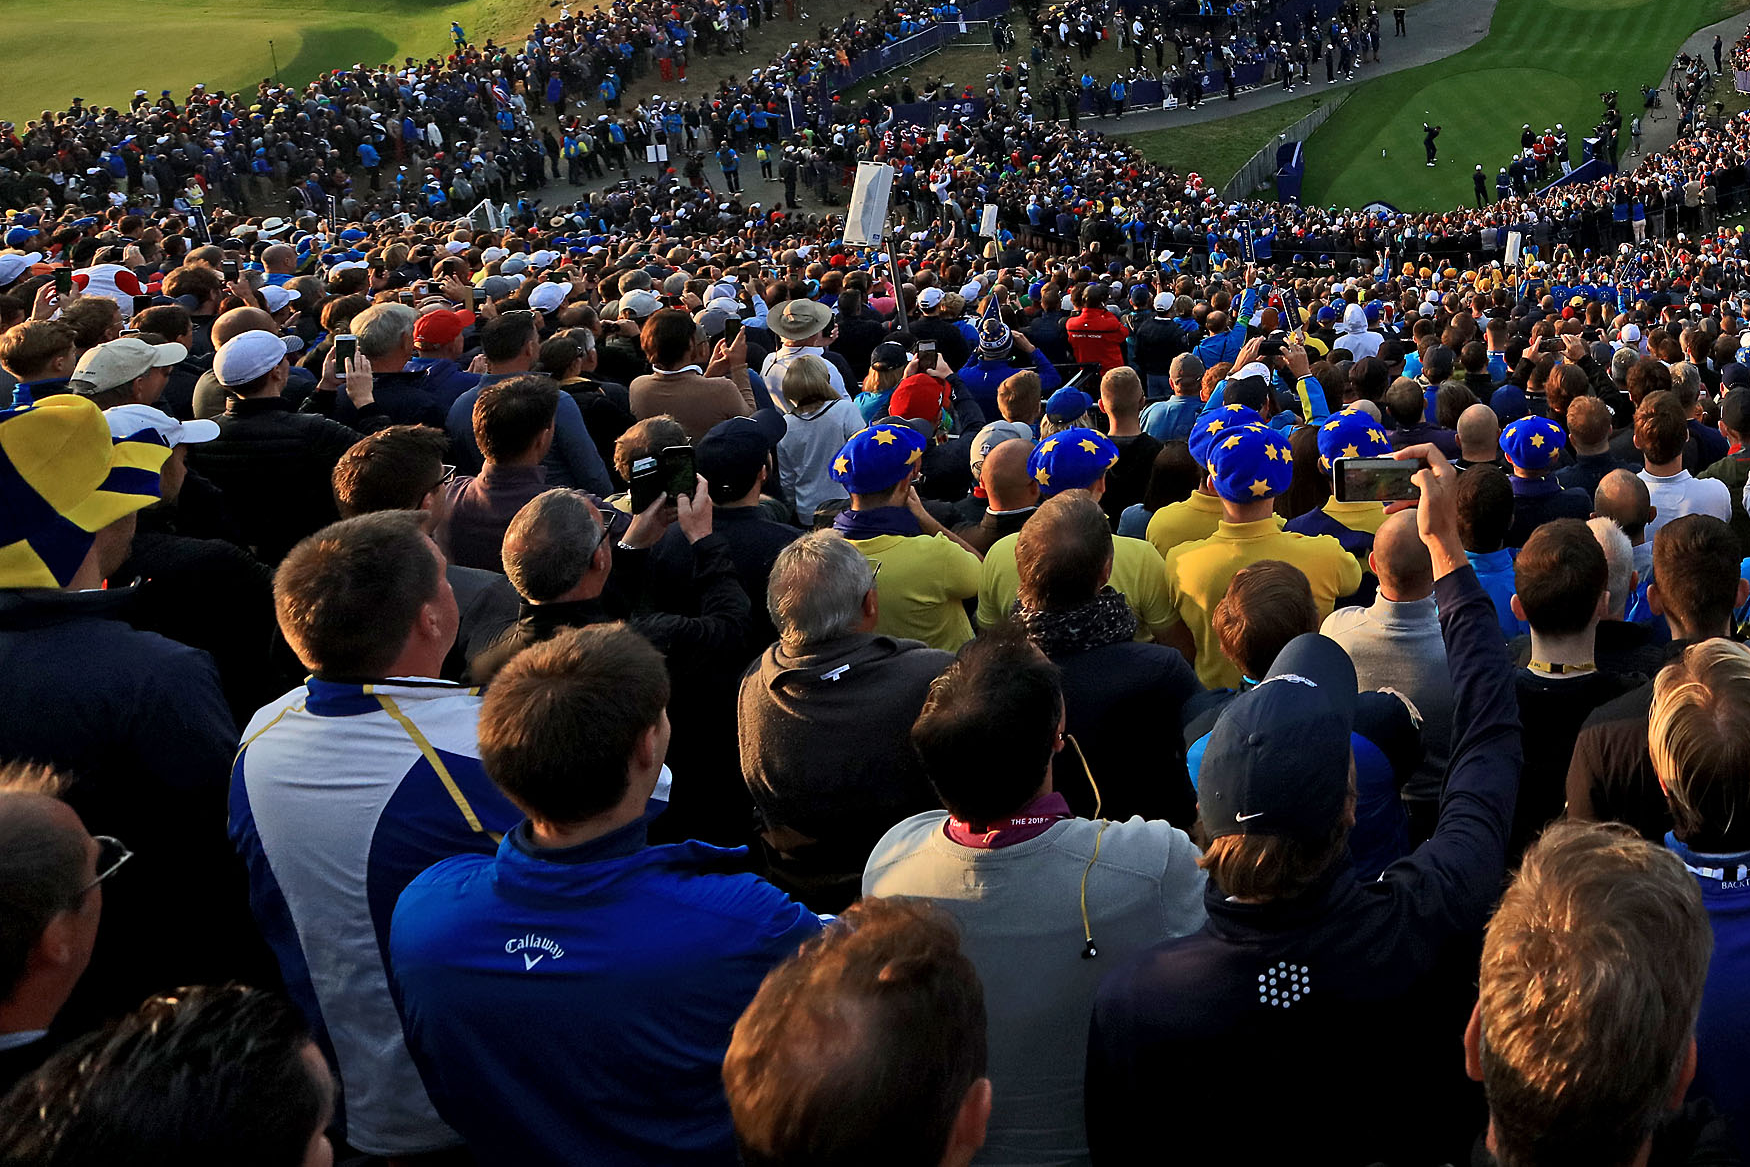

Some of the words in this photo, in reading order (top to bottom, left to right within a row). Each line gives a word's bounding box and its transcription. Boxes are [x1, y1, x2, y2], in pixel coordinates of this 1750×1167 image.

[1011, 818, 1026, 826] THE
[1028, 817, 1043, 825] 2018
[504, 932, 565, 960] Callaway
